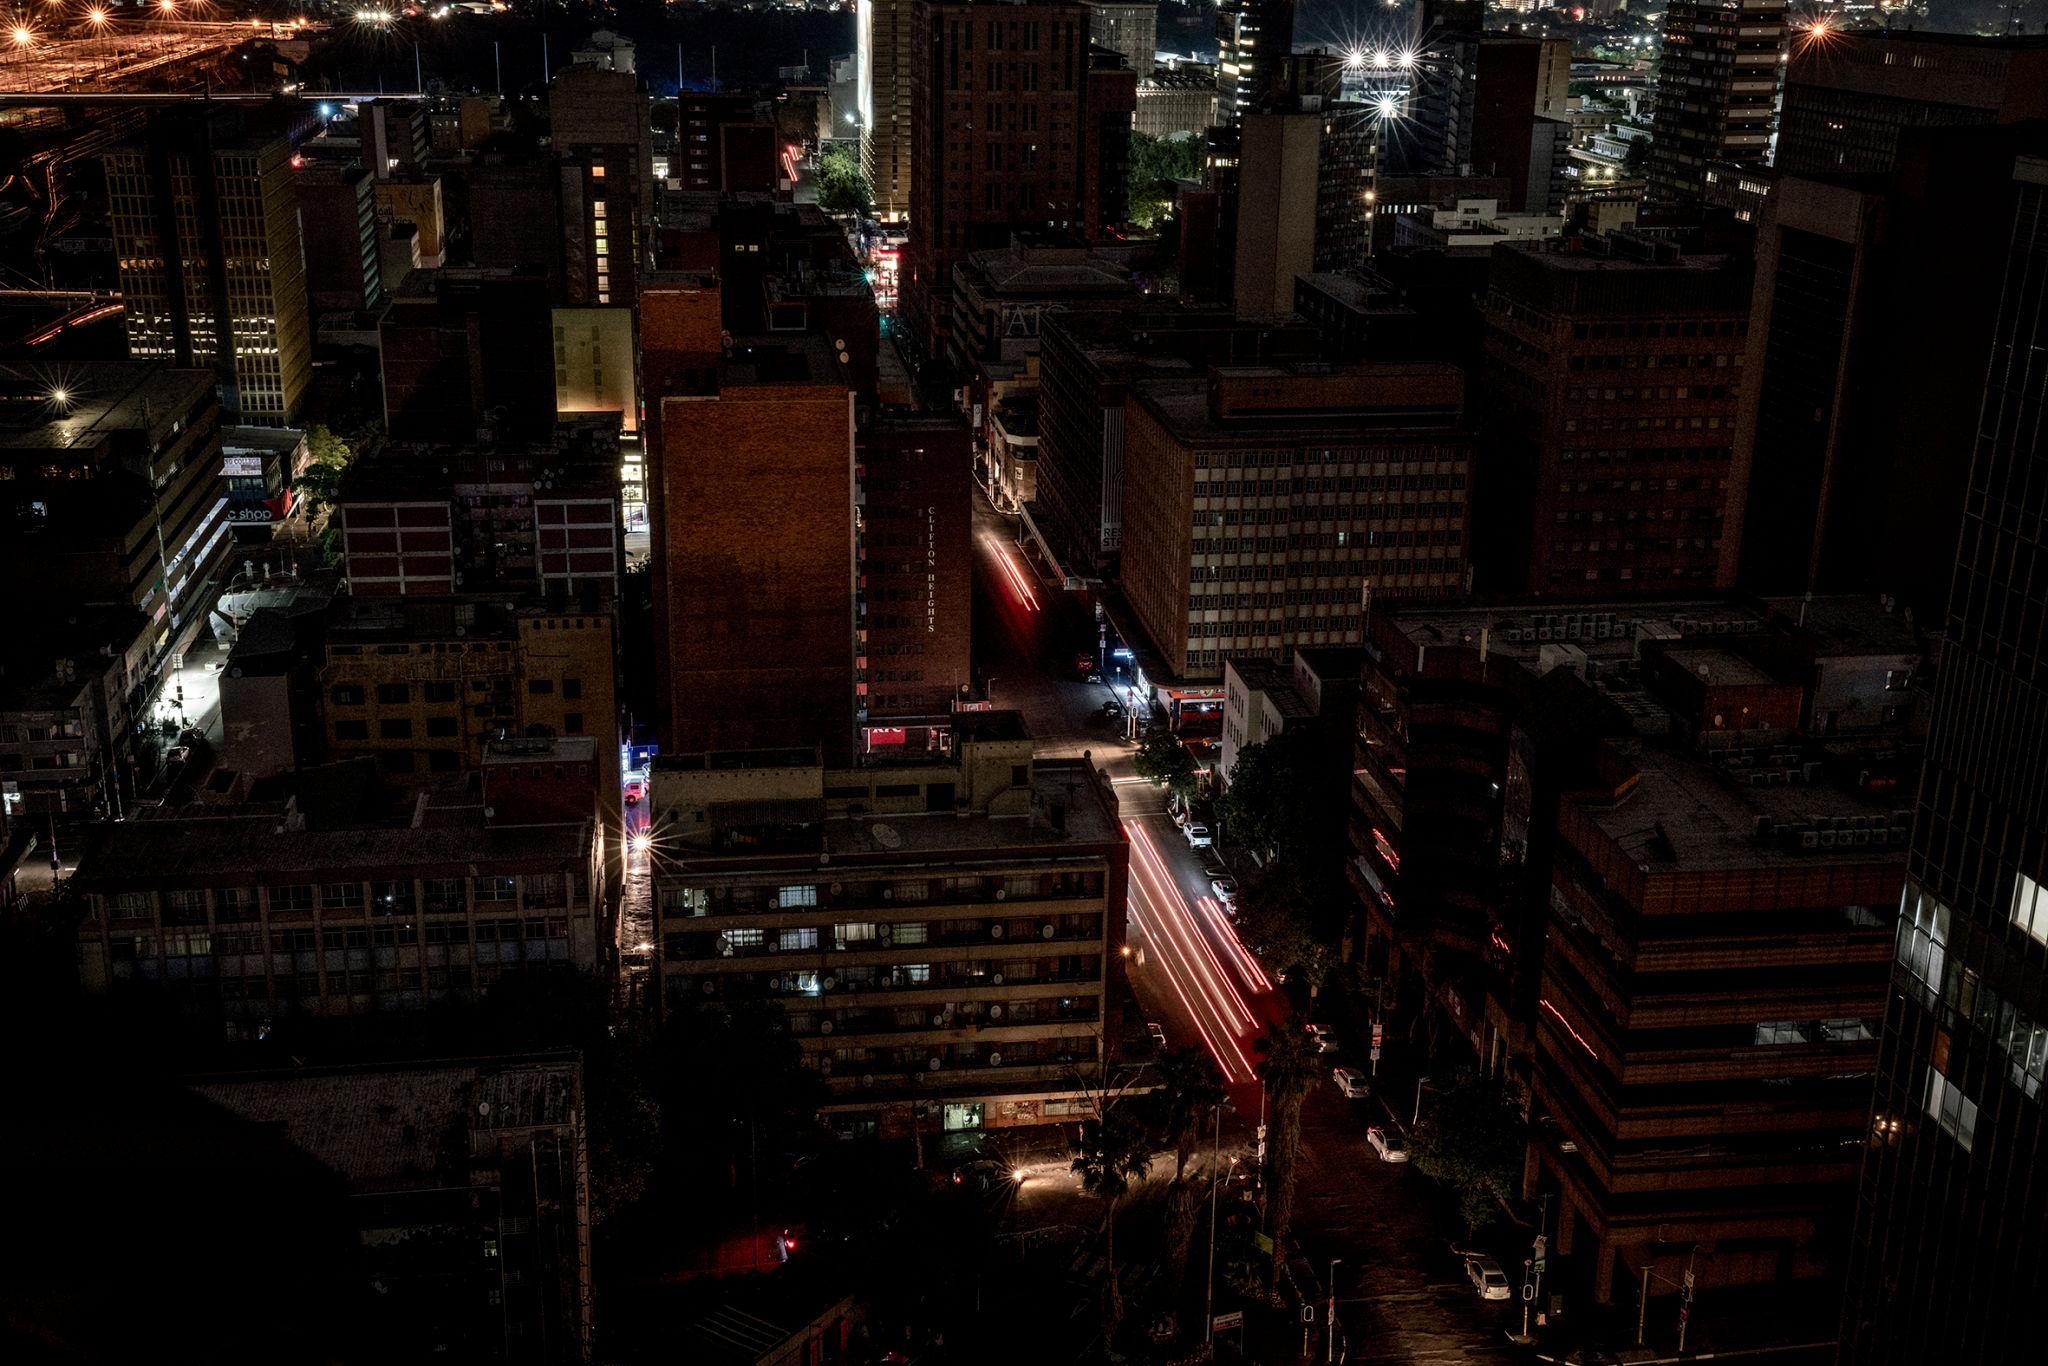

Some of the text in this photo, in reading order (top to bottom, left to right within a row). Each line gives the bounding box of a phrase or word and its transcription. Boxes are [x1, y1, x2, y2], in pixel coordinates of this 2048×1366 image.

[239, 508, 272, 521] shop
[927, 506, 935, 633] CLIFTON HEIGHTS
